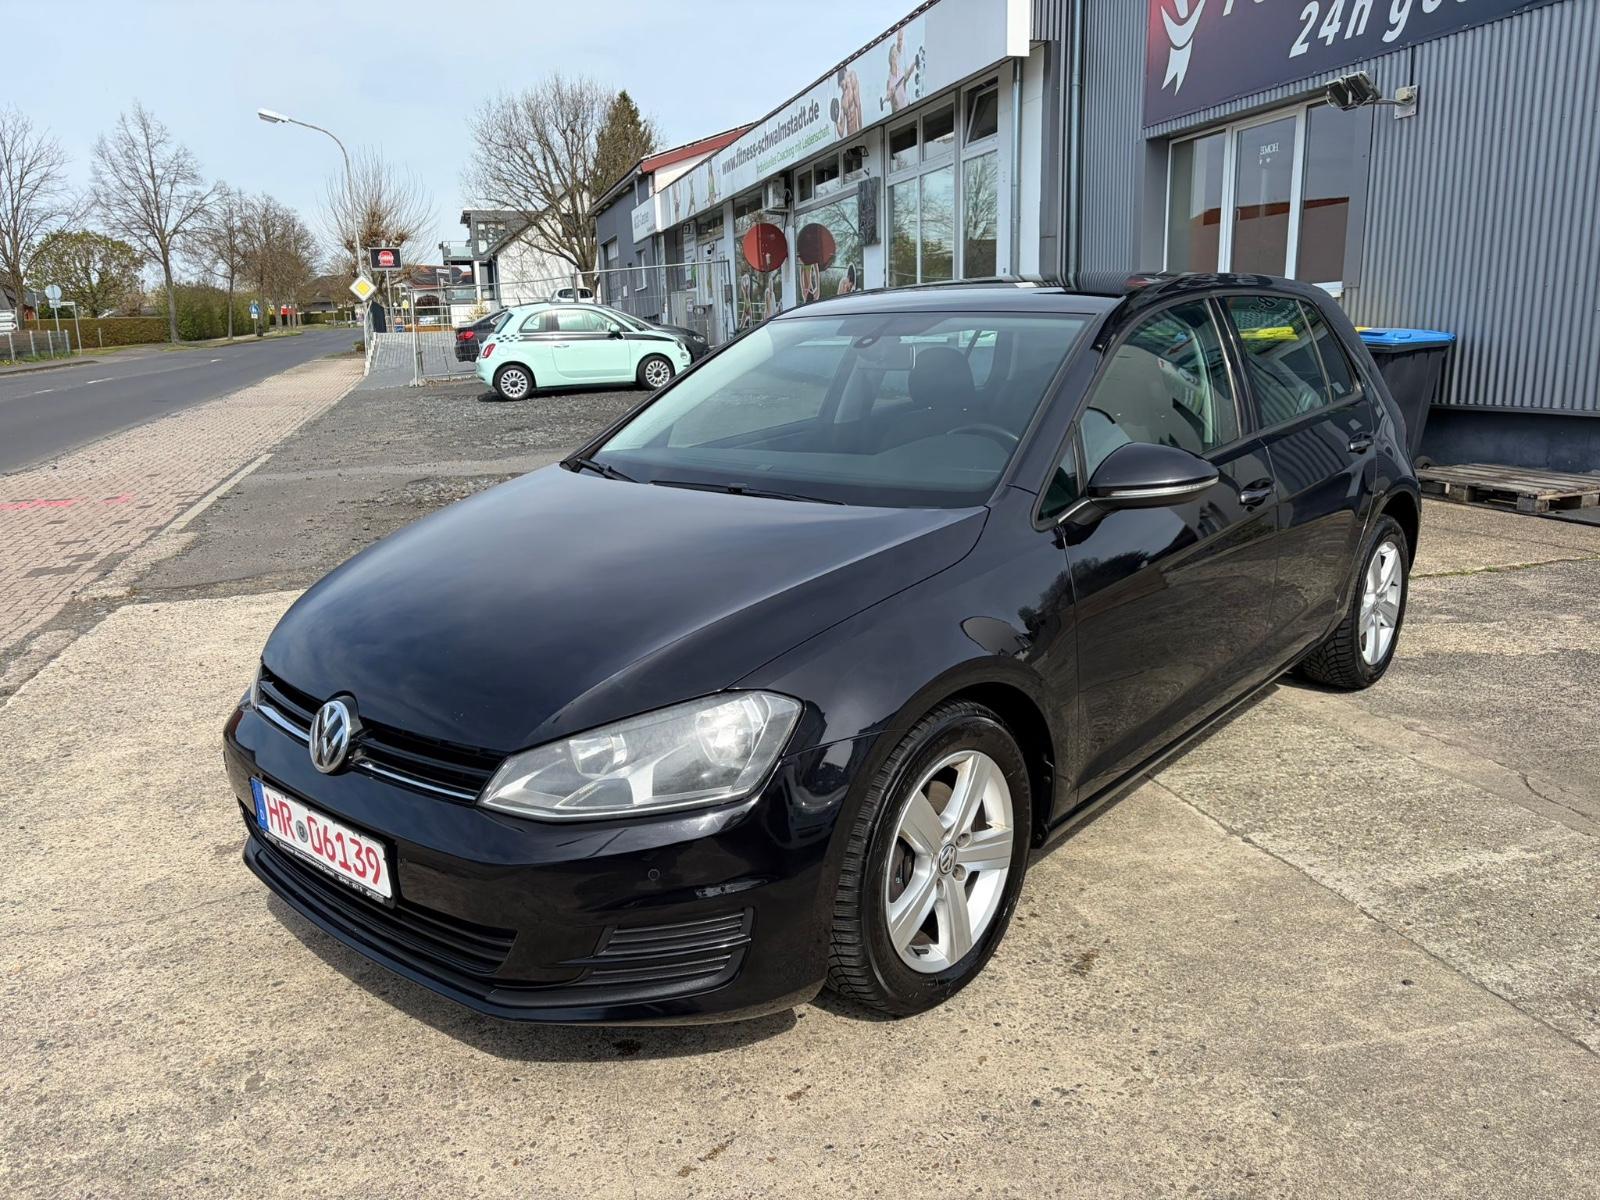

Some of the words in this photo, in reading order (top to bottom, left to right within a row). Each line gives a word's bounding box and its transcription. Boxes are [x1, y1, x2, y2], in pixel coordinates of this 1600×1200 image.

[722, 99, 820, 175] www.fitness-schwalmstadt.de
[265, 793, 296, 840] HR
[307, 815, 381, 885] 06139
